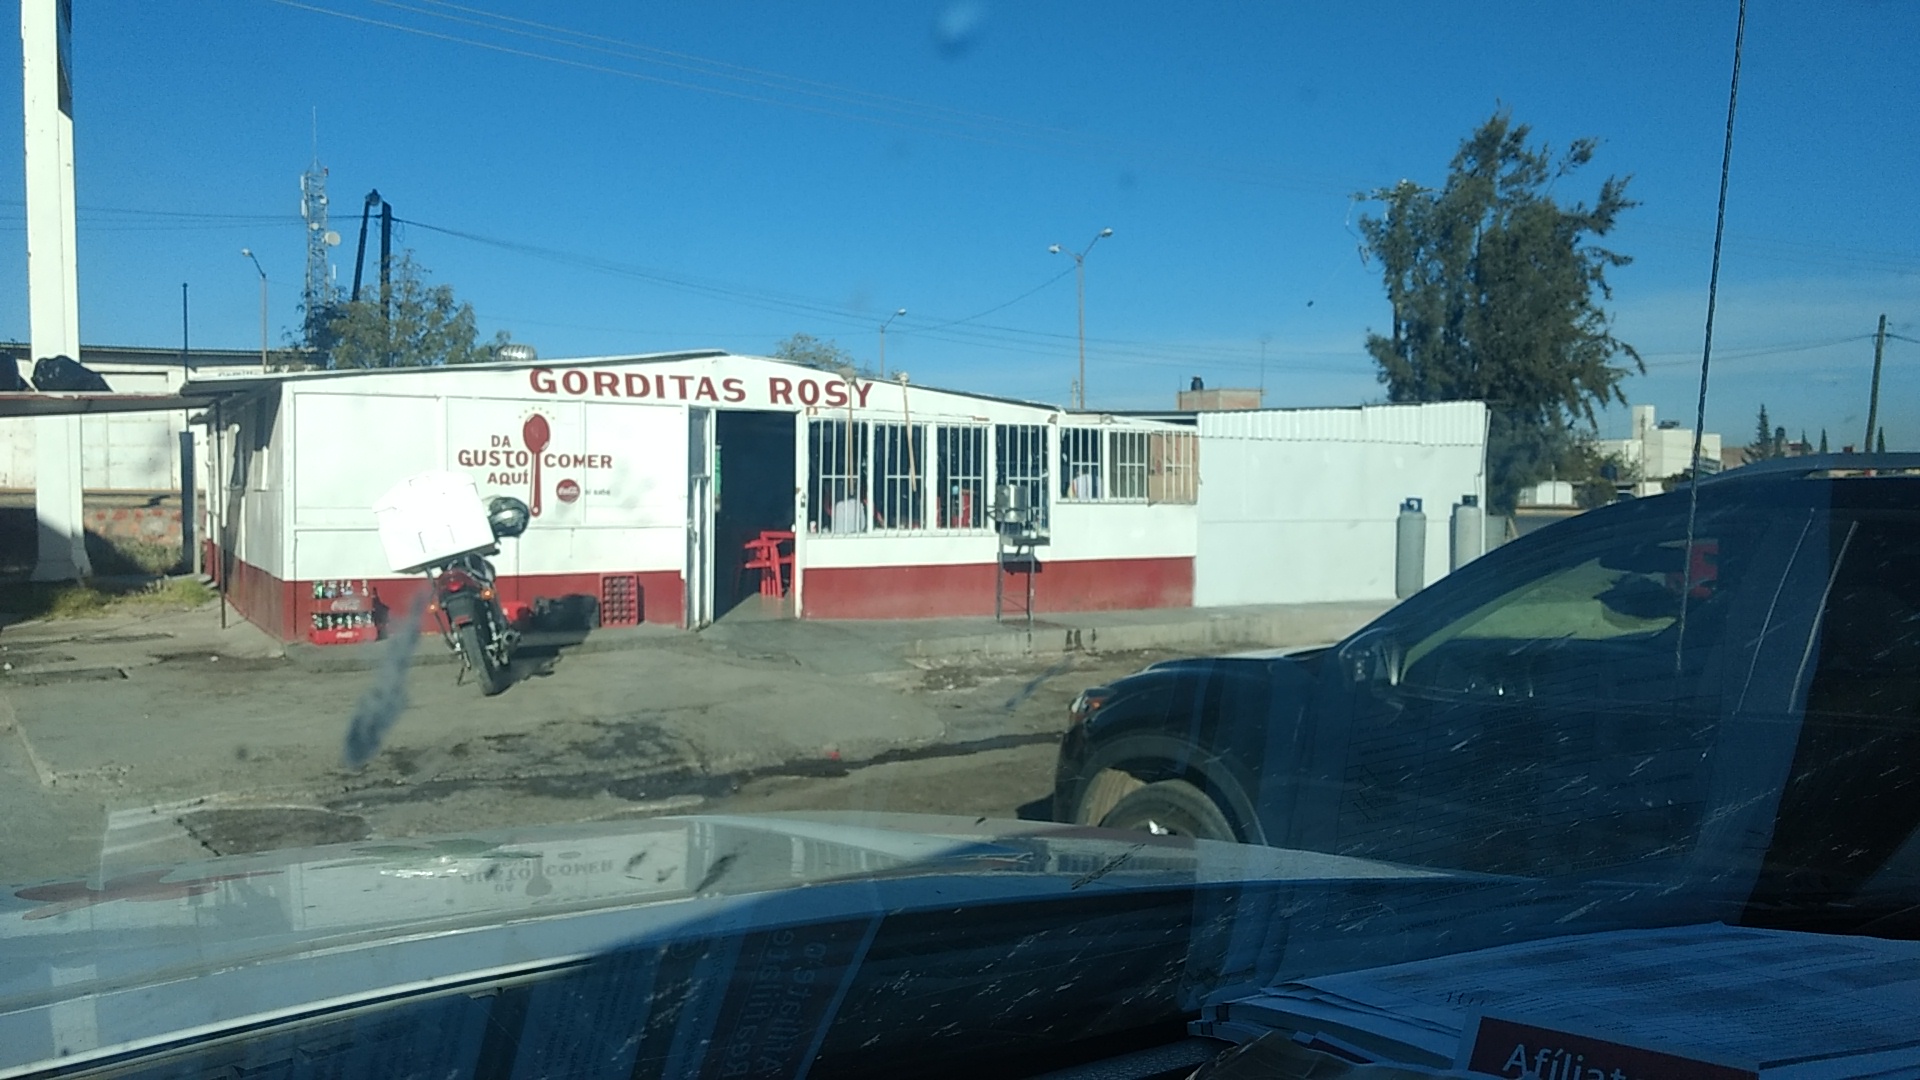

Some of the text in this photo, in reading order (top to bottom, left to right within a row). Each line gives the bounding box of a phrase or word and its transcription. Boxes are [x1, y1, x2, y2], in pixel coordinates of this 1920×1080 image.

[530, 368, 873, 408] GORDITAS ROSY
[491, 435, 511, 447] DA
[458, 449, 612, 468] GUSTO COMER
[487, 469, 529, 485] AQUÍ
